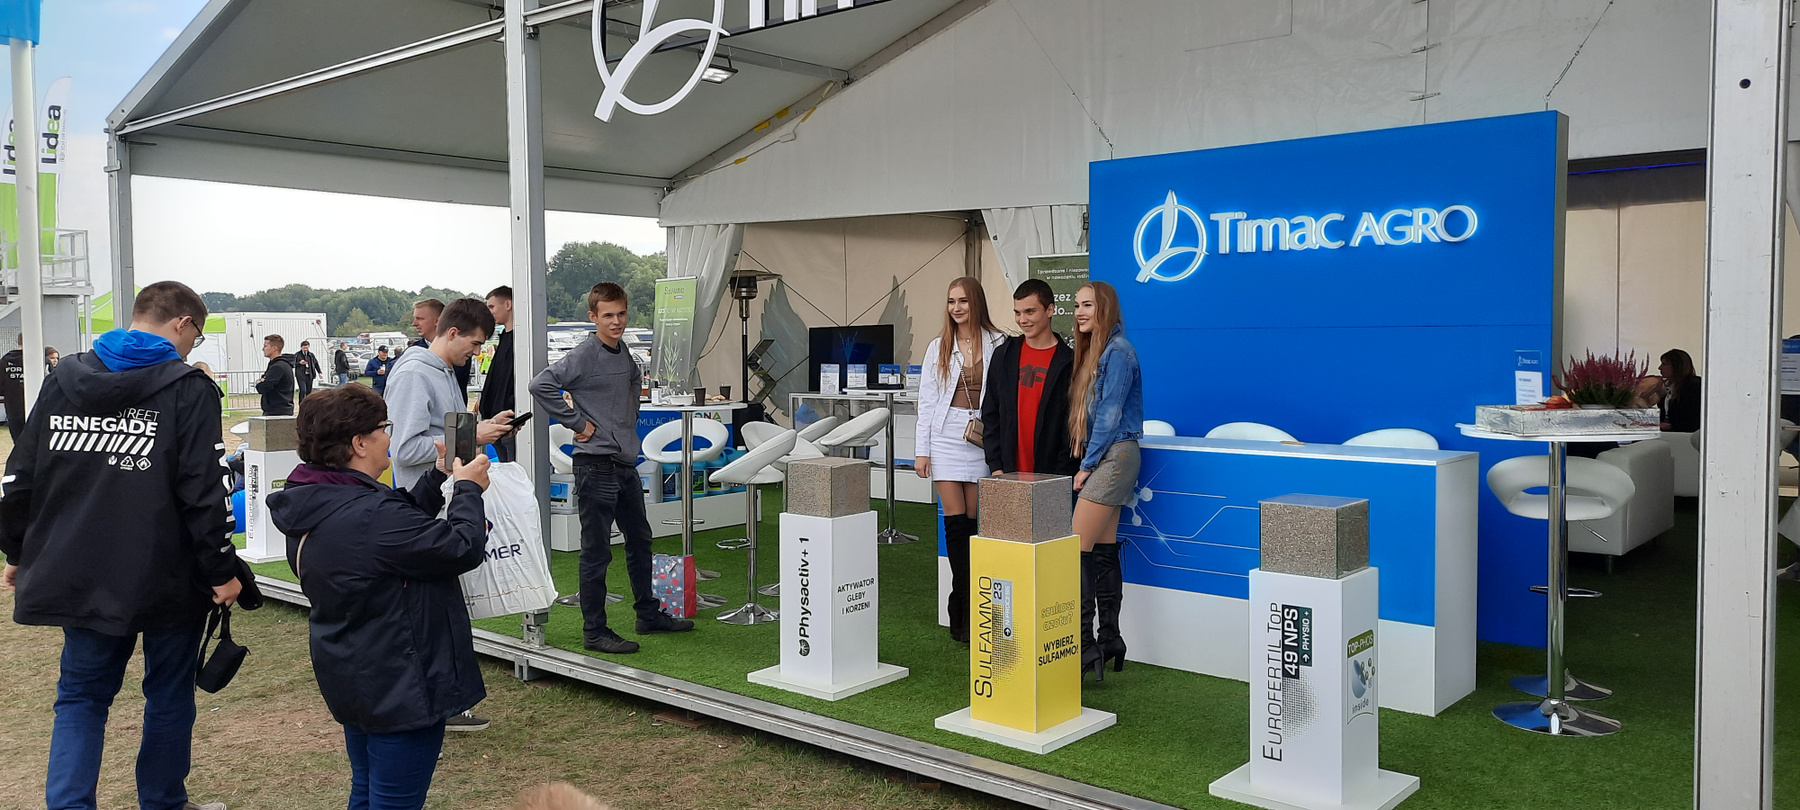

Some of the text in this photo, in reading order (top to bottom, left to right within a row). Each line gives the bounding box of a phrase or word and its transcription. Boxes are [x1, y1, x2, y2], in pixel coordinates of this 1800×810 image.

[41, 104, 61, 164] Lidea
[1210, 204, 1477, 254] Timac AGRO
[1053, 293, 1071, 302] zez
[49, 415, 159, 437] RENEGADE
[837, 577, 875, 593] AKTYWATOR
[993, 582, 1003, 600] 23
[846, 591, 866, 602] GLEBY
[845, 601, 871, 614] KORZENI
[1043, 634, 1074, 653] WYBIERZ
[1284, 607, 1299, 676] 49 NPS
[1302, 618, 1310, 651] PHYSIO
[1347, 634, 1374, 655] TOP-PHOS
[1038, 644, 1079, 666] SULFAMMO!
[1262, 639, 1282, 762] EUROFERTIL
